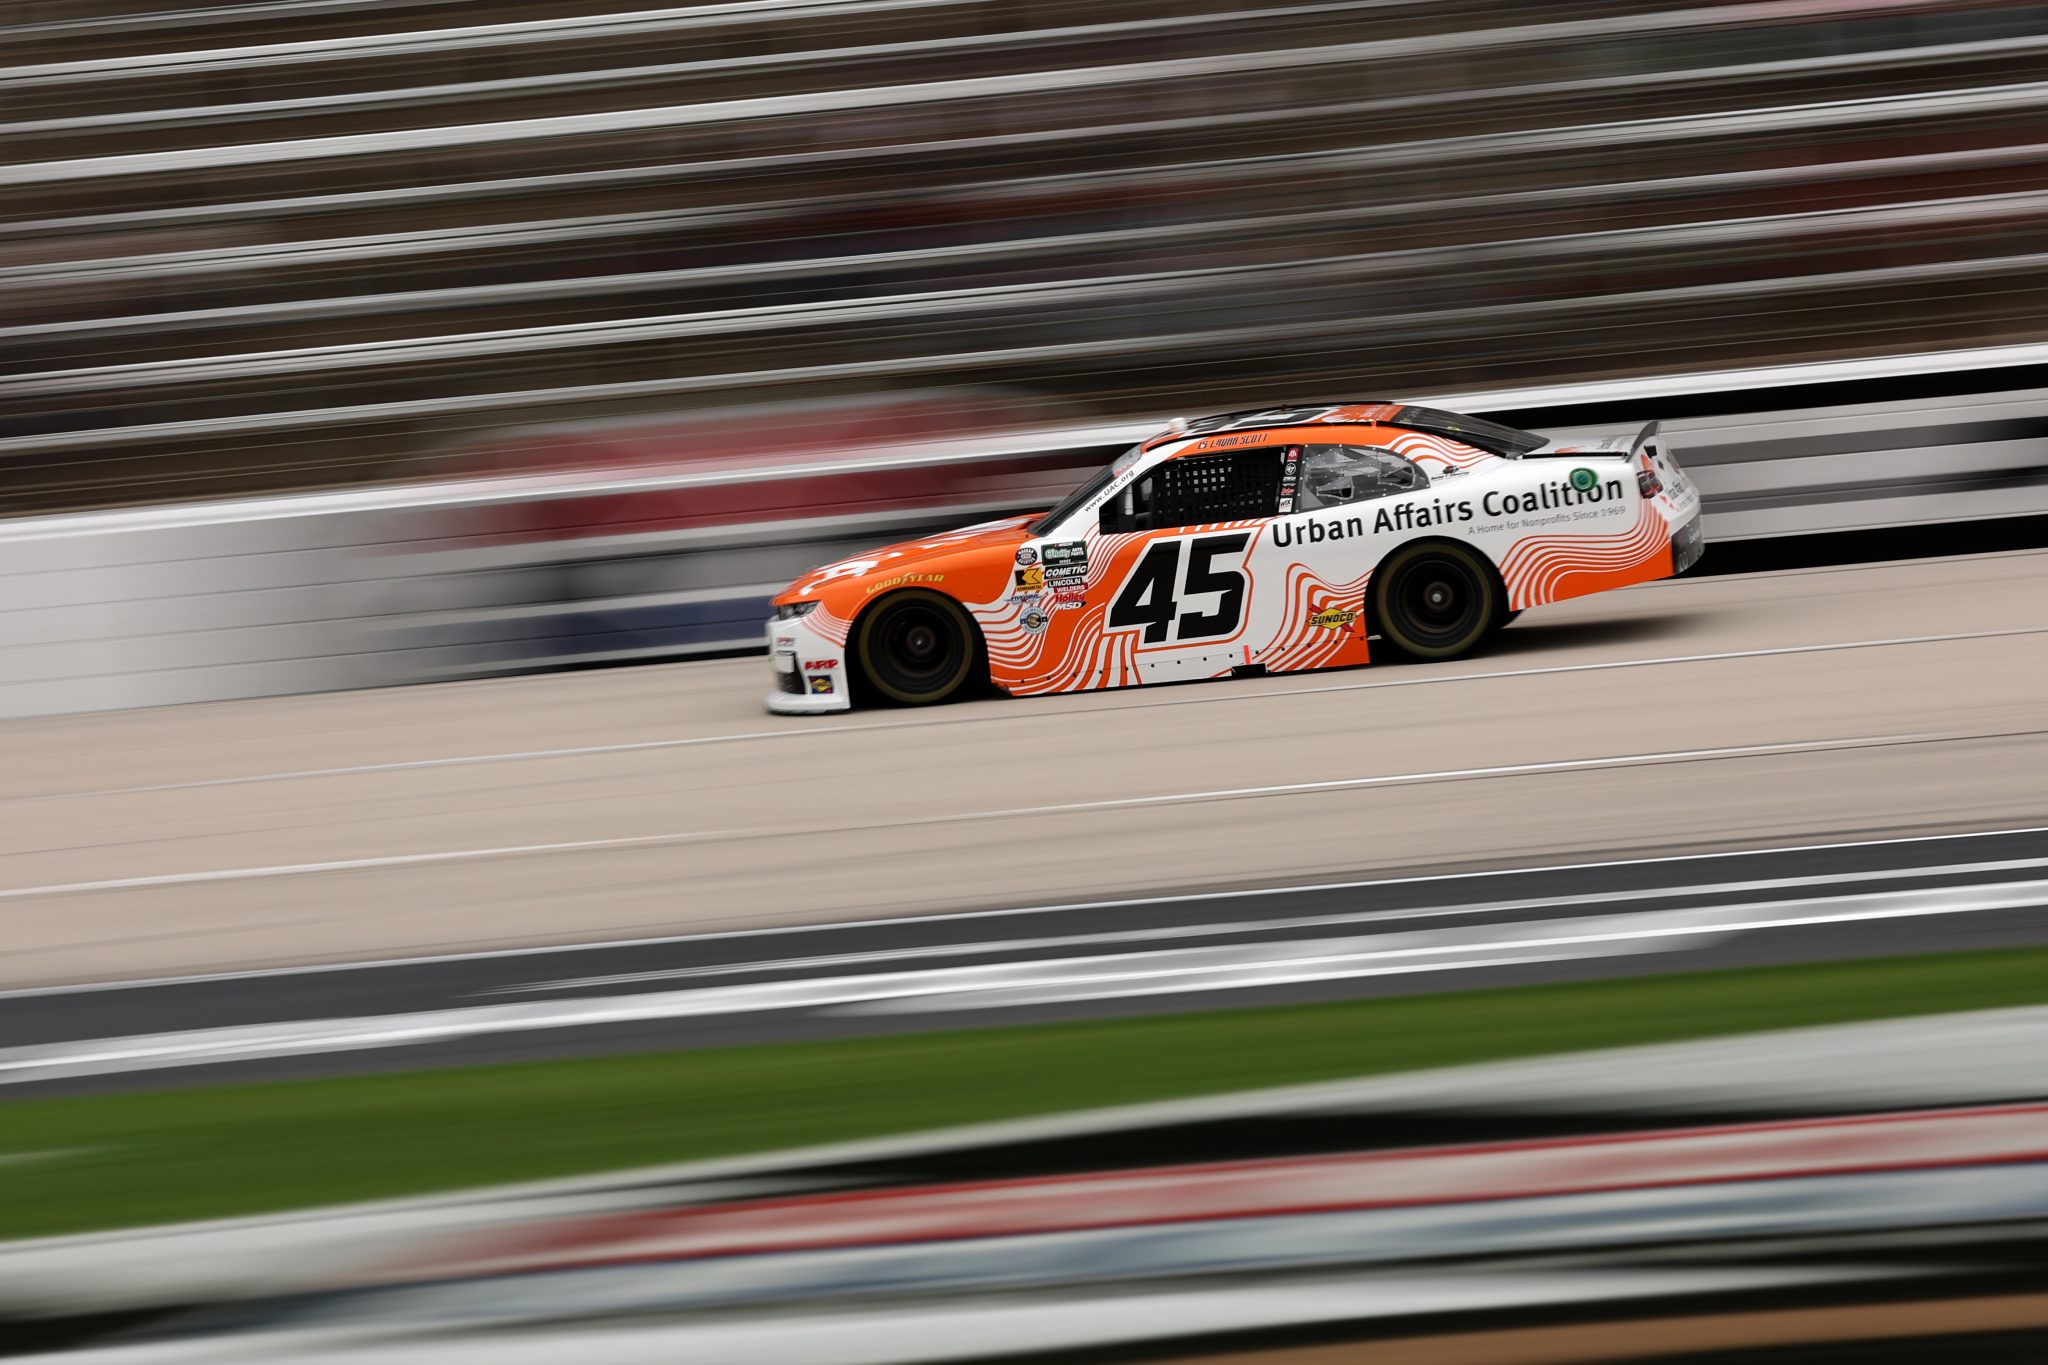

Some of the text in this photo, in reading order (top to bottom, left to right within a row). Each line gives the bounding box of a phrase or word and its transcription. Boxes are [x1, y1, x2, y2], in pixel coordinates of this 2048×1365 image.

[1240, 433, 1268, 445] SCOTT
[1084, 470, 1135, 512] www.UAC.org
[1272, 517, 1364, 548] Urban
[1373, 497, 1473, 534] Affairs
[1482, 478, 1624, 517] Coaliton
[1477, 524, 1504, 534] Home
[1506, 520, 1520, 530] for
[1522, 513, 1571, 528] Nonprofits
[1573, 510, 1598, 521] Since
[1601, 505, 1626, 517] 1969
[1045, 565, 1087, 577] COMETIC
[866, 572, 944, 594] GOODYEAR
[1048, 578, 1081, 587] LINCOLN
[1056, 584, 1086, 593] WELDERS
[1109, 532, 1252, 644] 45
[1055, 592, 1086, 603] Holley
[1055, 601, 1082, 610] MSD
[1310, 612, 1354, 625] SUNOCO
